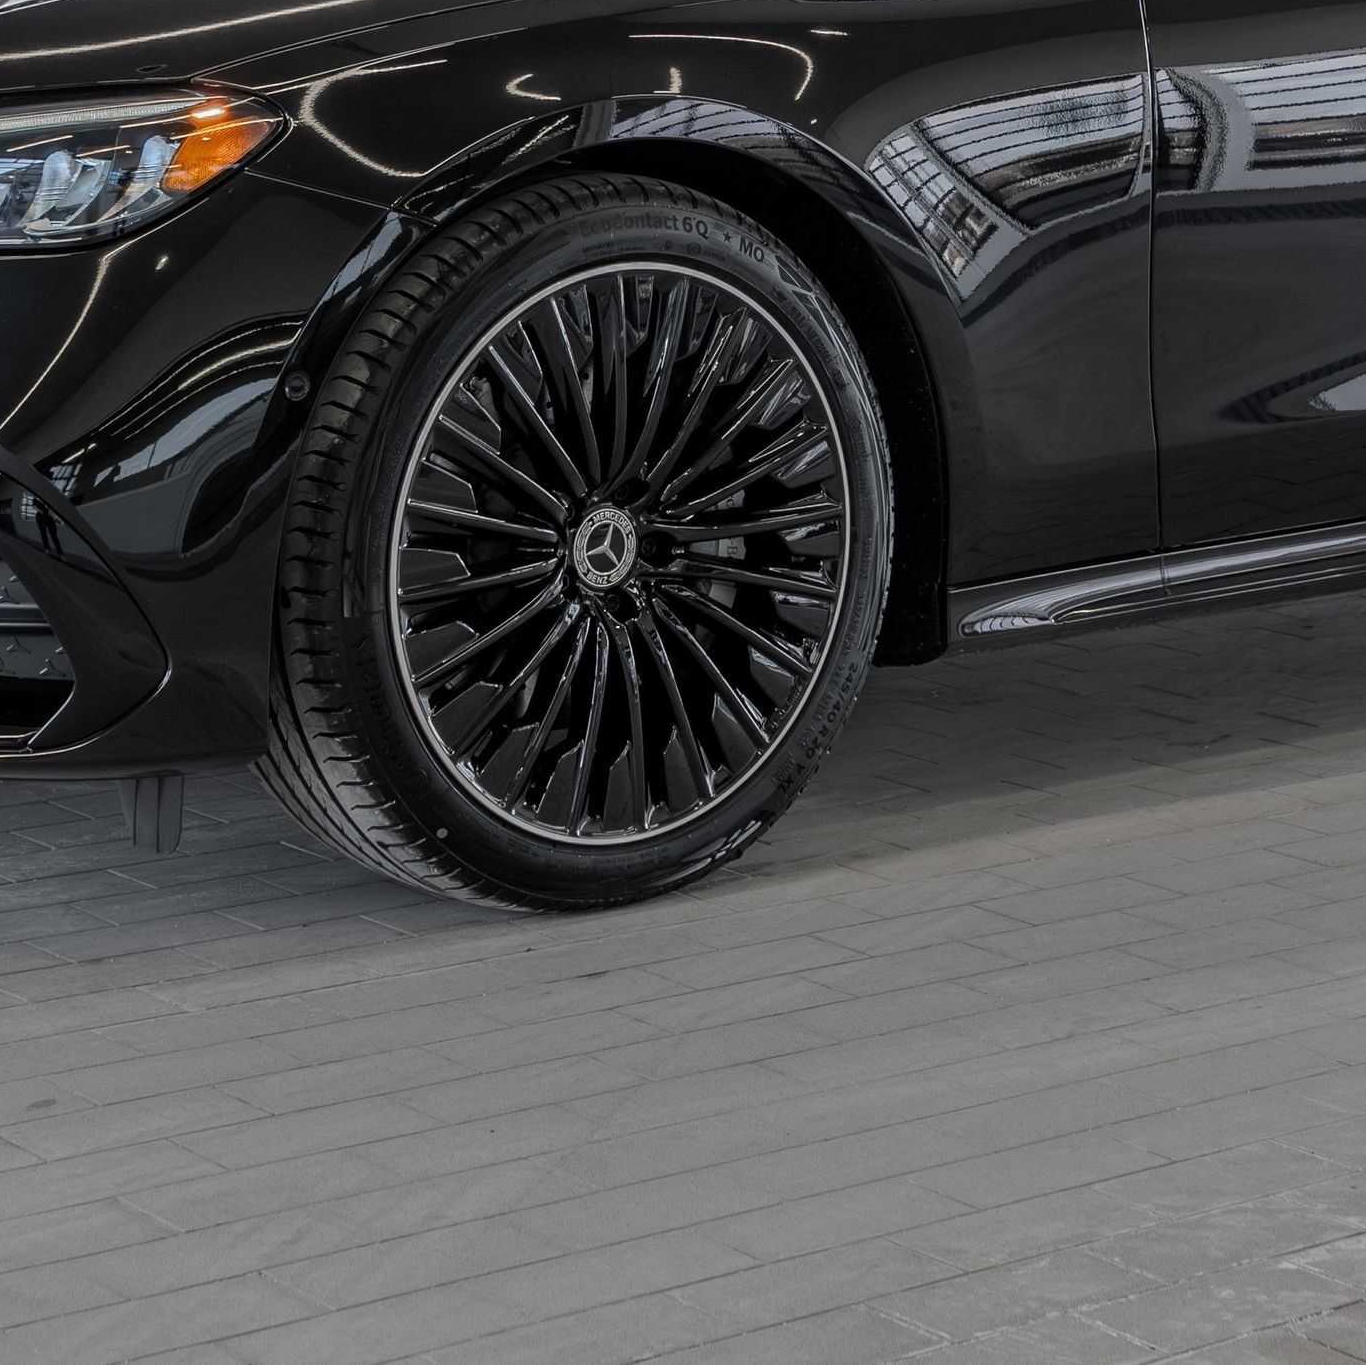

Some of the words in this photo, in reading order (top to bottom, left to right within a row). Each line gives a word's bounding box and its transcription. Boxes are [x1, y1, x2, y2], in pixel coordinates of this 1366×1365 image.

[738, 236, 766, 264] MO
[592, 511, 632, 534] MERCEDES
[586, 570, 609, 585] BENZ
